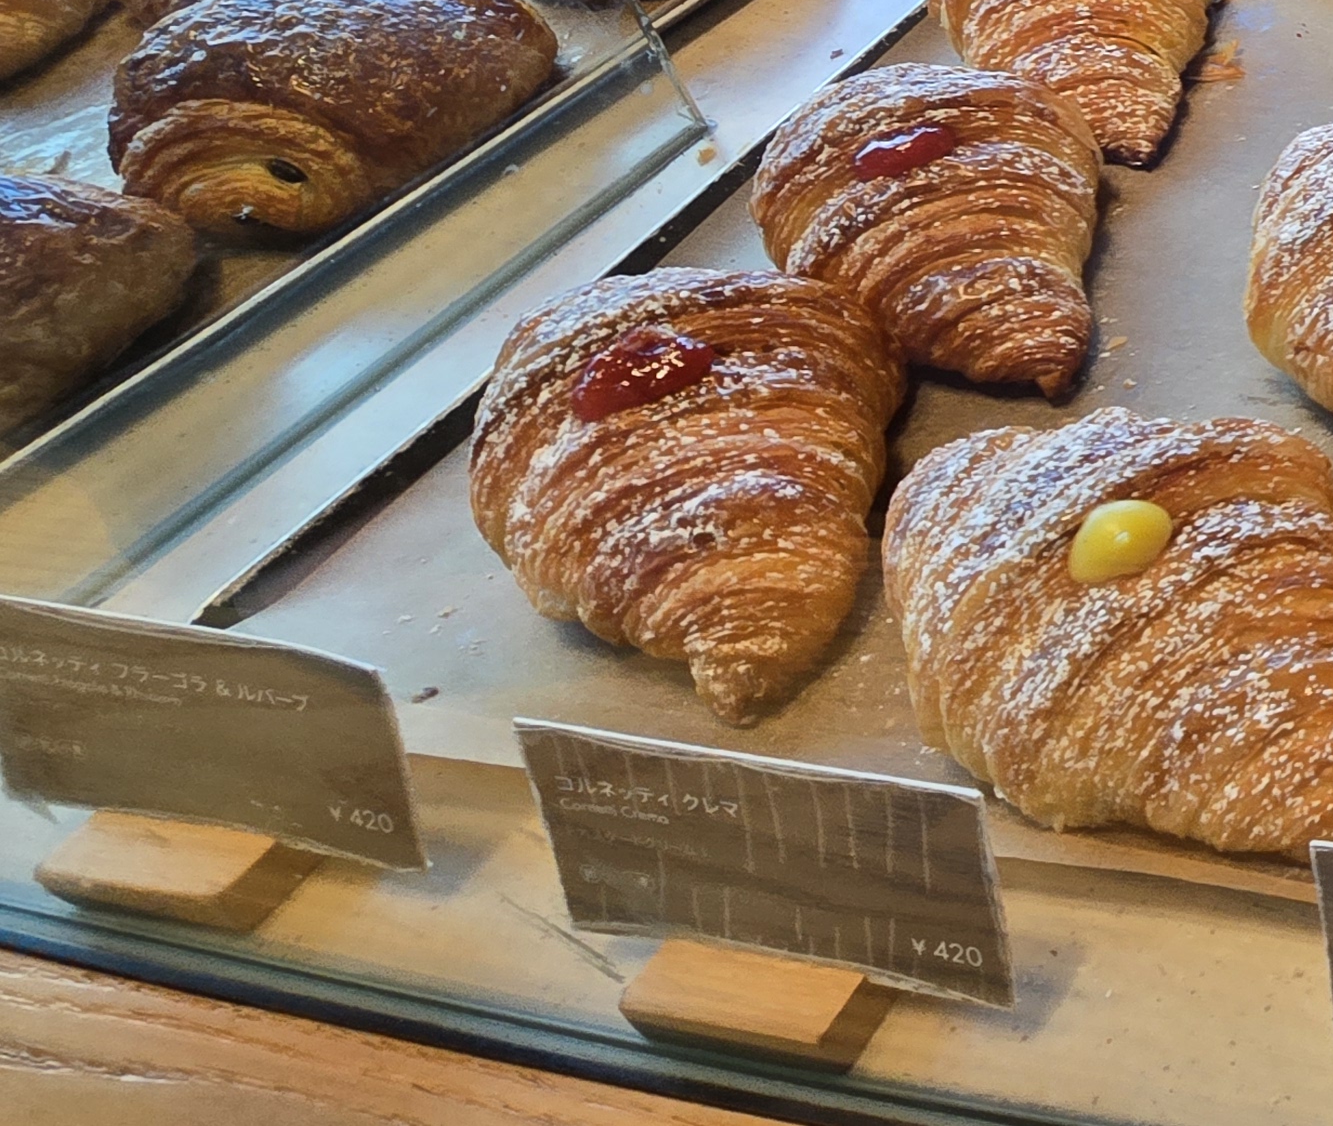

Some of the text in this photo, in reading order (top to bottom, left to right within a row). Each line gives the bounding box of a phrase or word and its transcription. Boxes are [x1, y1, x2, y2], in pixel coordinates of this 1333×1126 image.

[215, 678, 232, 697] &
[554, 775, 740, 819] コルネッティ クレマ
[329, 799, 395, 835] ¥420
[911, 937, 984, 968] ¥420
